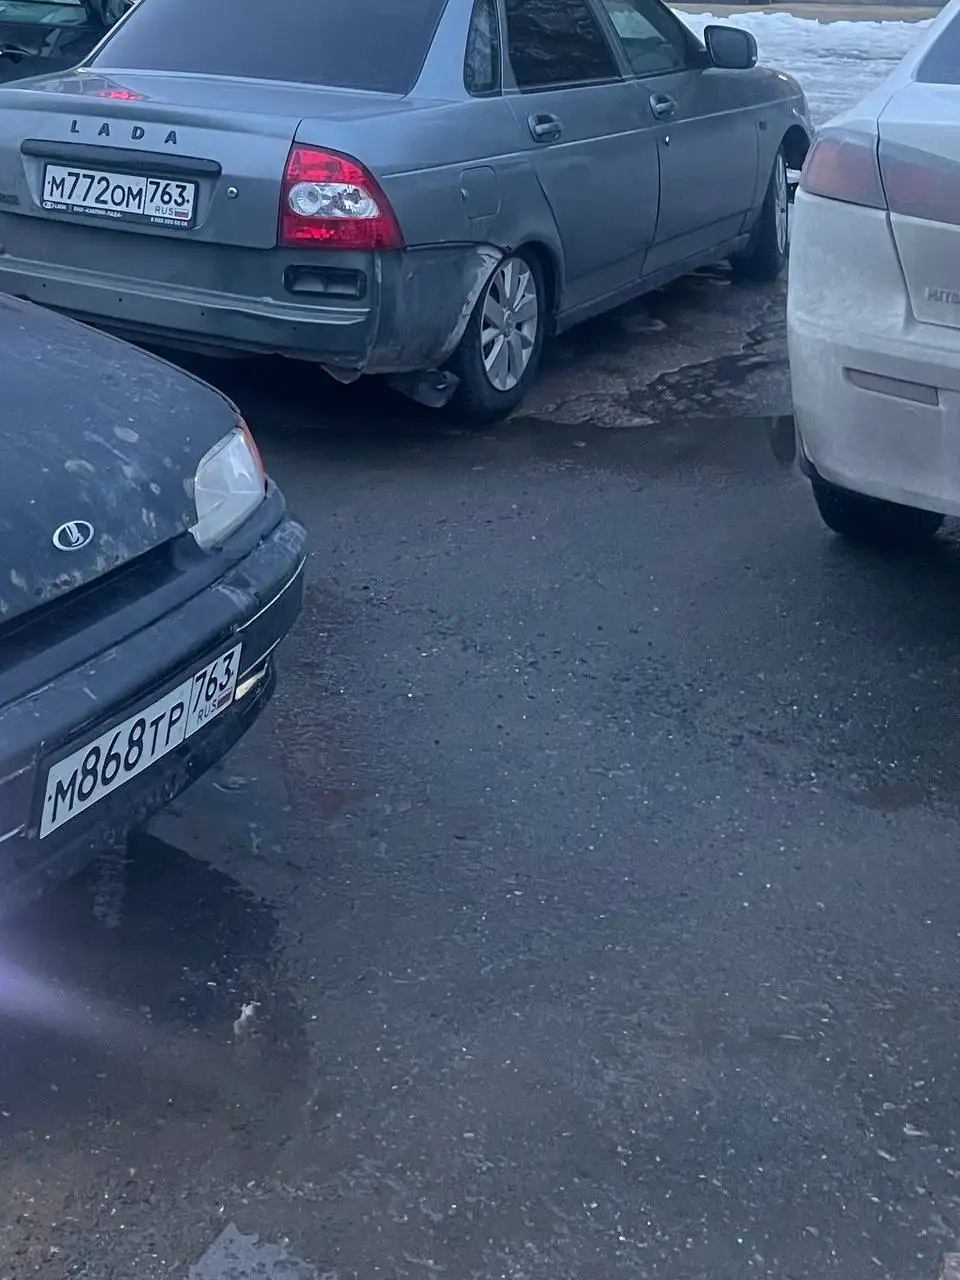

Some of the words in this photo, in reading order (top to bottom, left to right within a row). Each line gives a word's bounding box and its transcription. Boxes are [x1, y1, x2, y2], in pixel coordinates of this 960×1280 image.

[71, 120, 177, 144] LADA
[49, 172, 143, 209] М772ОМ
[149, 180, 187, 207] 763
[155, 206, 174, 216] RUS
[197, 702, 217, 721] RUS
[51, 701, 184, 823] М868ТР
[193, 651, 235, 713] 763
